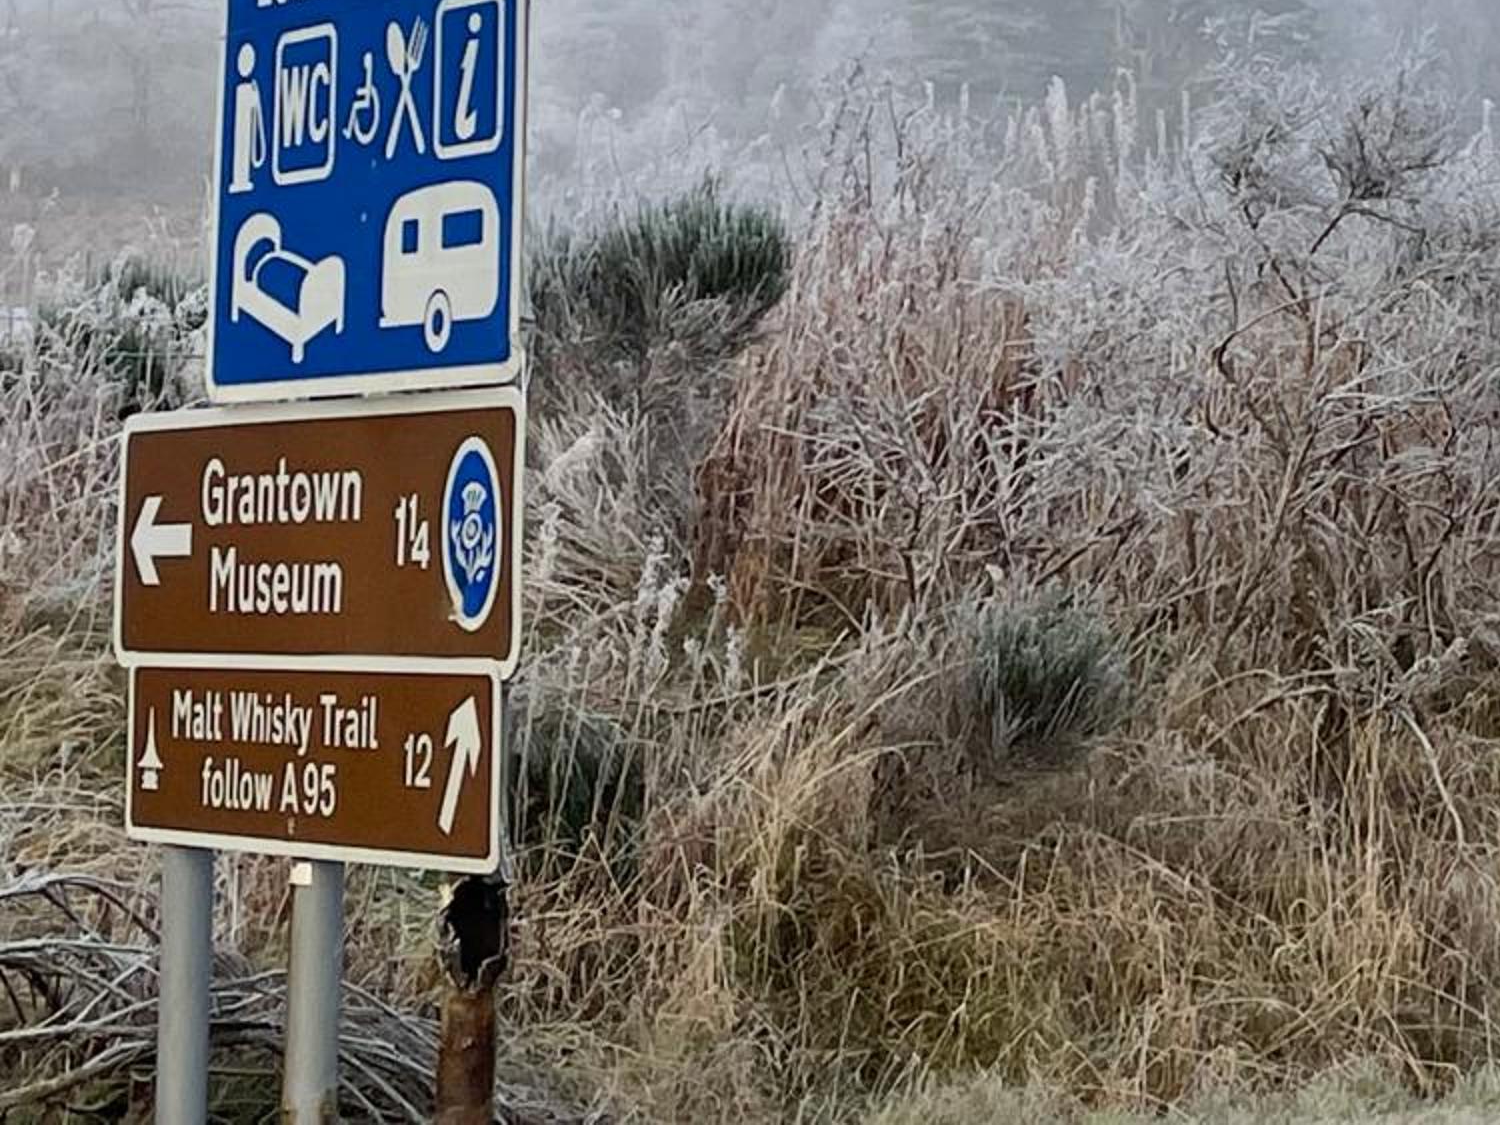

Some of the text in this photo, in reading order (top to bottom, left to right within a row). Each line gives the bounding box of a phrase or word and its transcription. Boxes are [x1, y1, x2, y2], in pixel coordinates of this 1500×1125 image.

[281, 62, 330, 148] WC
[202, 457, 363, 526] Grantown
[209, 546, 342, 614] Museum
[172, 689, 379, 756] Malt Whisky Trail
[202, 757, 272, 812] follow
[404, 733, 433, 789] 12
